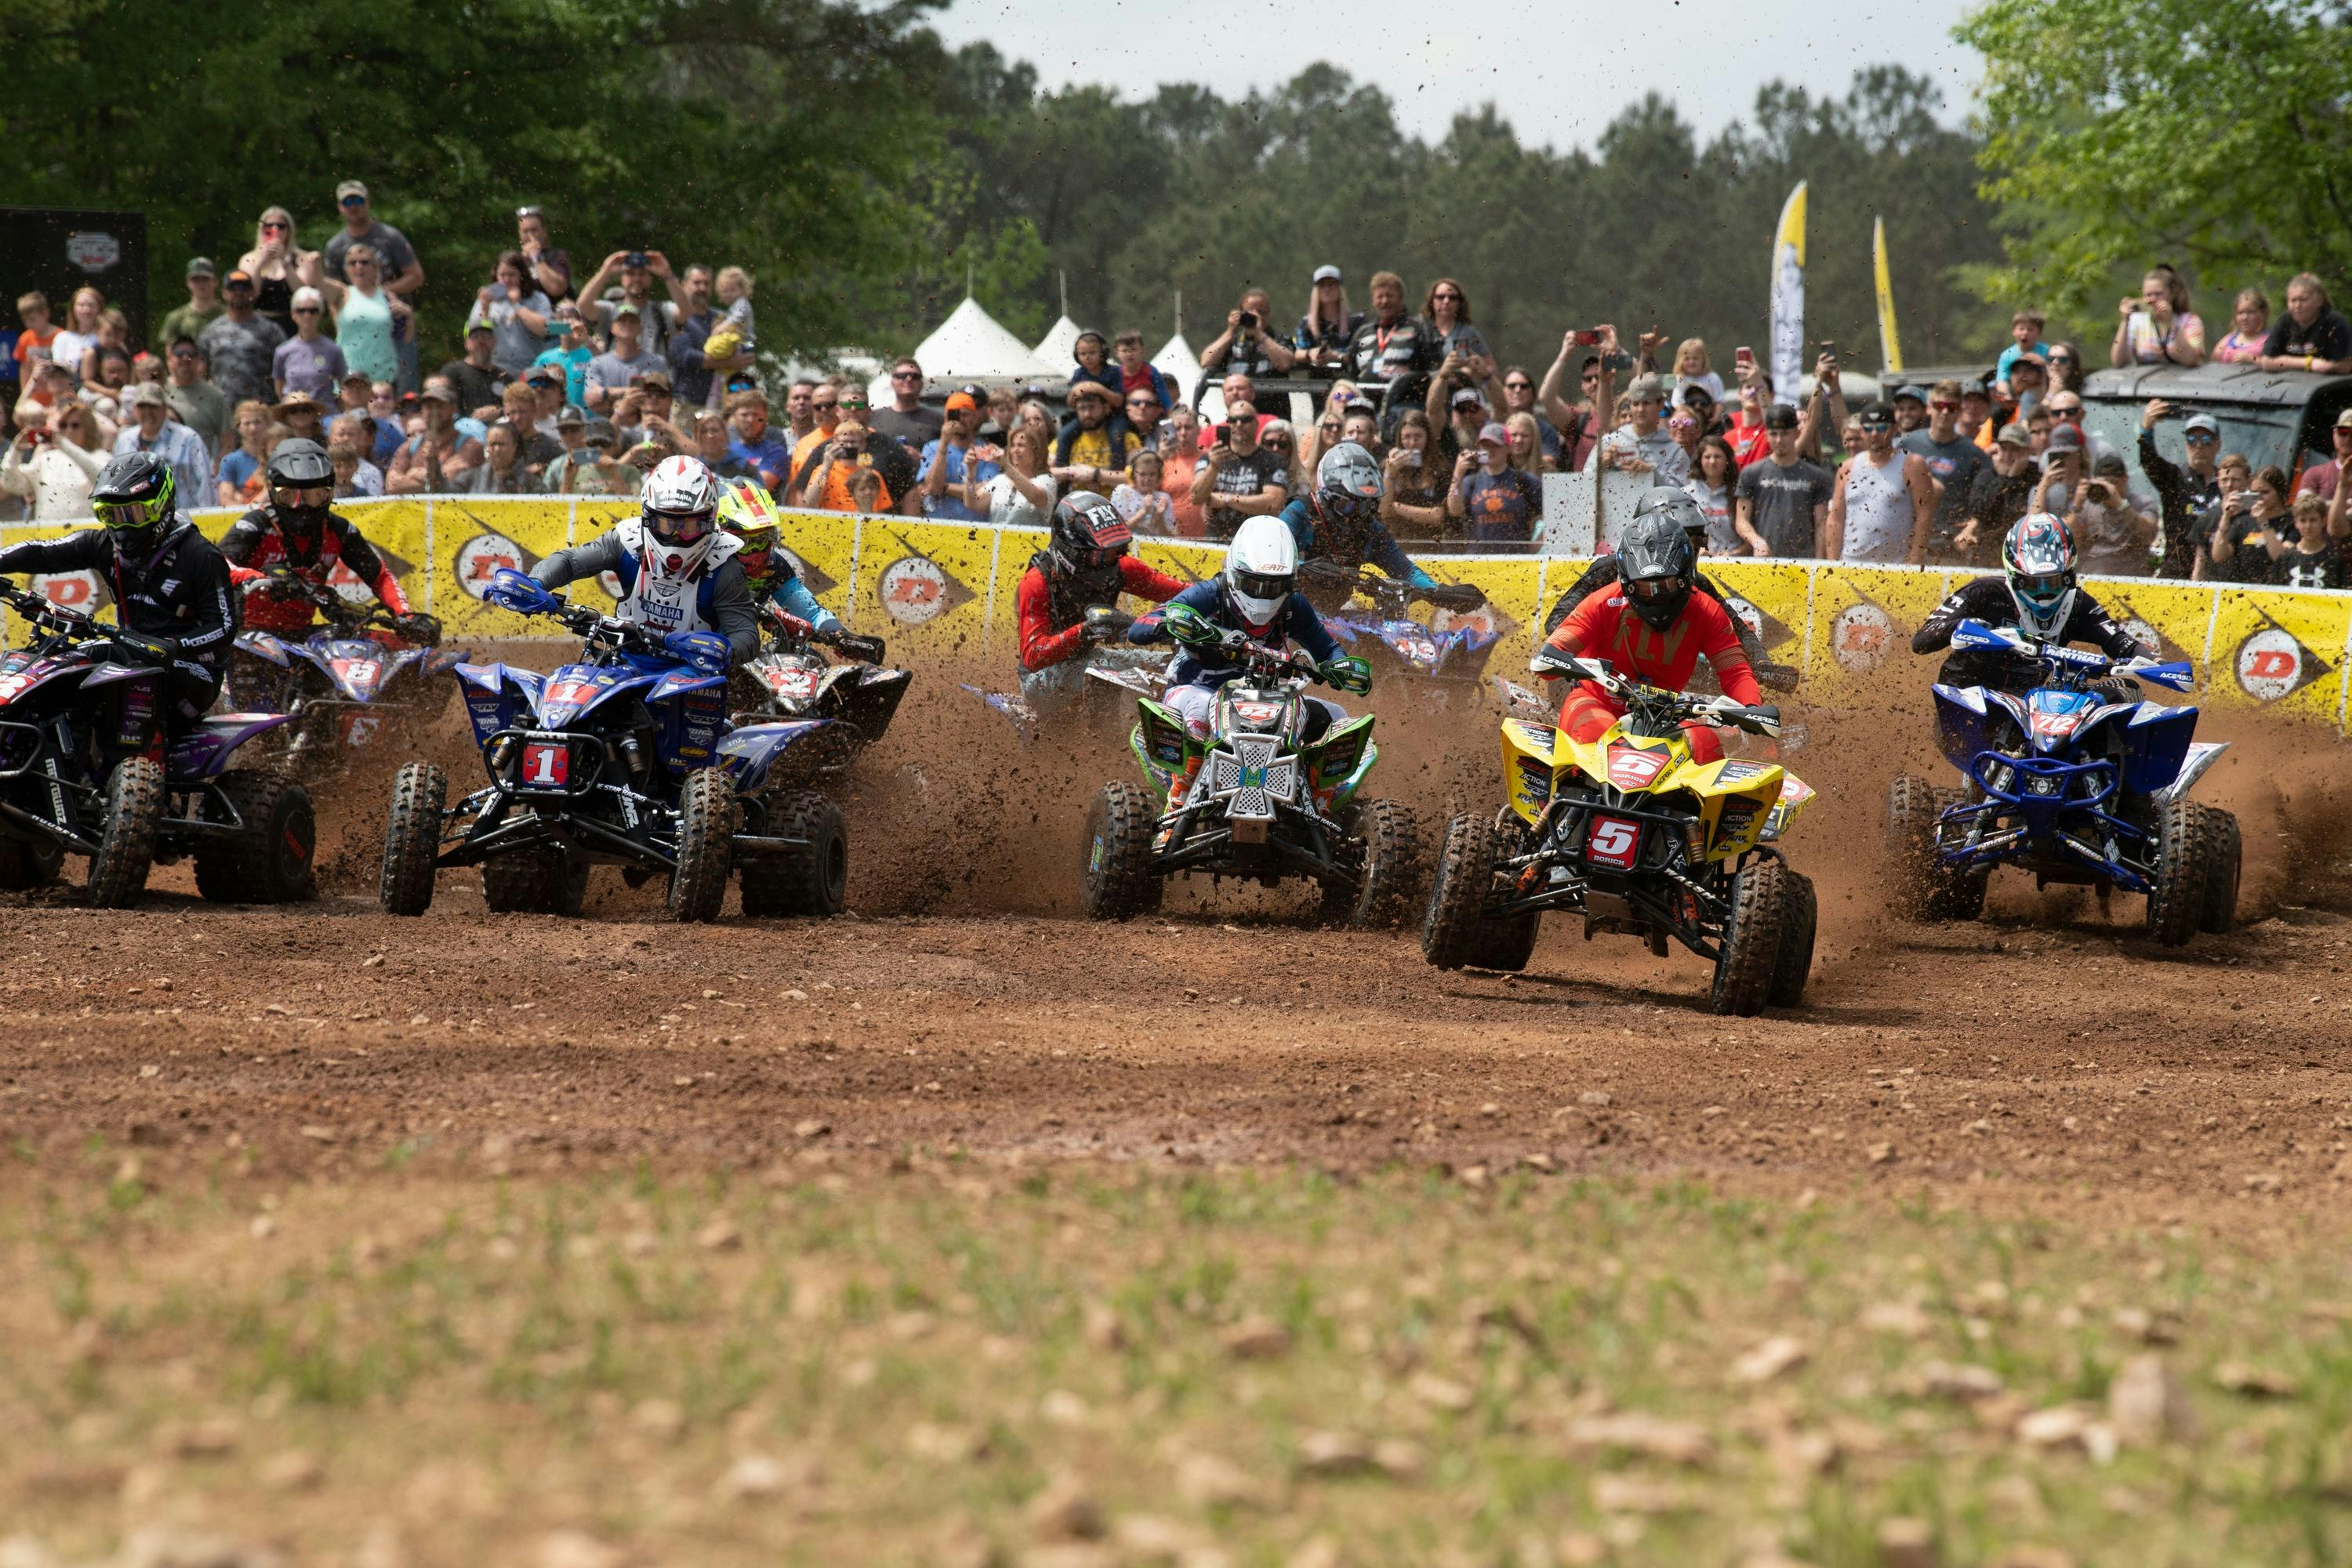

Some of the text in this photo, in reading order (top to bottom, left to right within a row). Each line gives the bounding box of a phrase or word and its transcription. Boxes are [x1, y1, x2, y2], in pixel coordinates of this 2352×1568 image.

[1256, 564, 1288, 572] LEATT
[643, 603, 681, 619] YAMAHA
[1612, 608, 1690, 665] FLY
[1955, 633, 1990, 644] ACERBIS
[1617, 655, 1650, 670] ACERBIS
[2045, 648, 2103, 666] RENTHAL
[2245, 650, 2296, 678] D
[2159, 672, 2193, 682] ACERBIS
[557, 684, 579, 702] 1
[688, 688, 721, 699] YAMAHA
[1240, 706, 1280, 719] 521
[1745, 713, 1780, 726] ACERBIS
[2038, 715, 2073, 731] 712
[533, 749, 555, 782] 1
[1611, 753, 1661, 776] 5
[1730, 766, 1760, 775] ACTION
[1521, 773, 1547, 786] ACTION
[1613, 773, 1646, 785] BORICH
[622, 787, 648, 802] RACING
[1192, 799, 1215, 811] RACING
[1592, 821, 1637, 855] 5
[1593, 855, 1625, 866] BORICH
